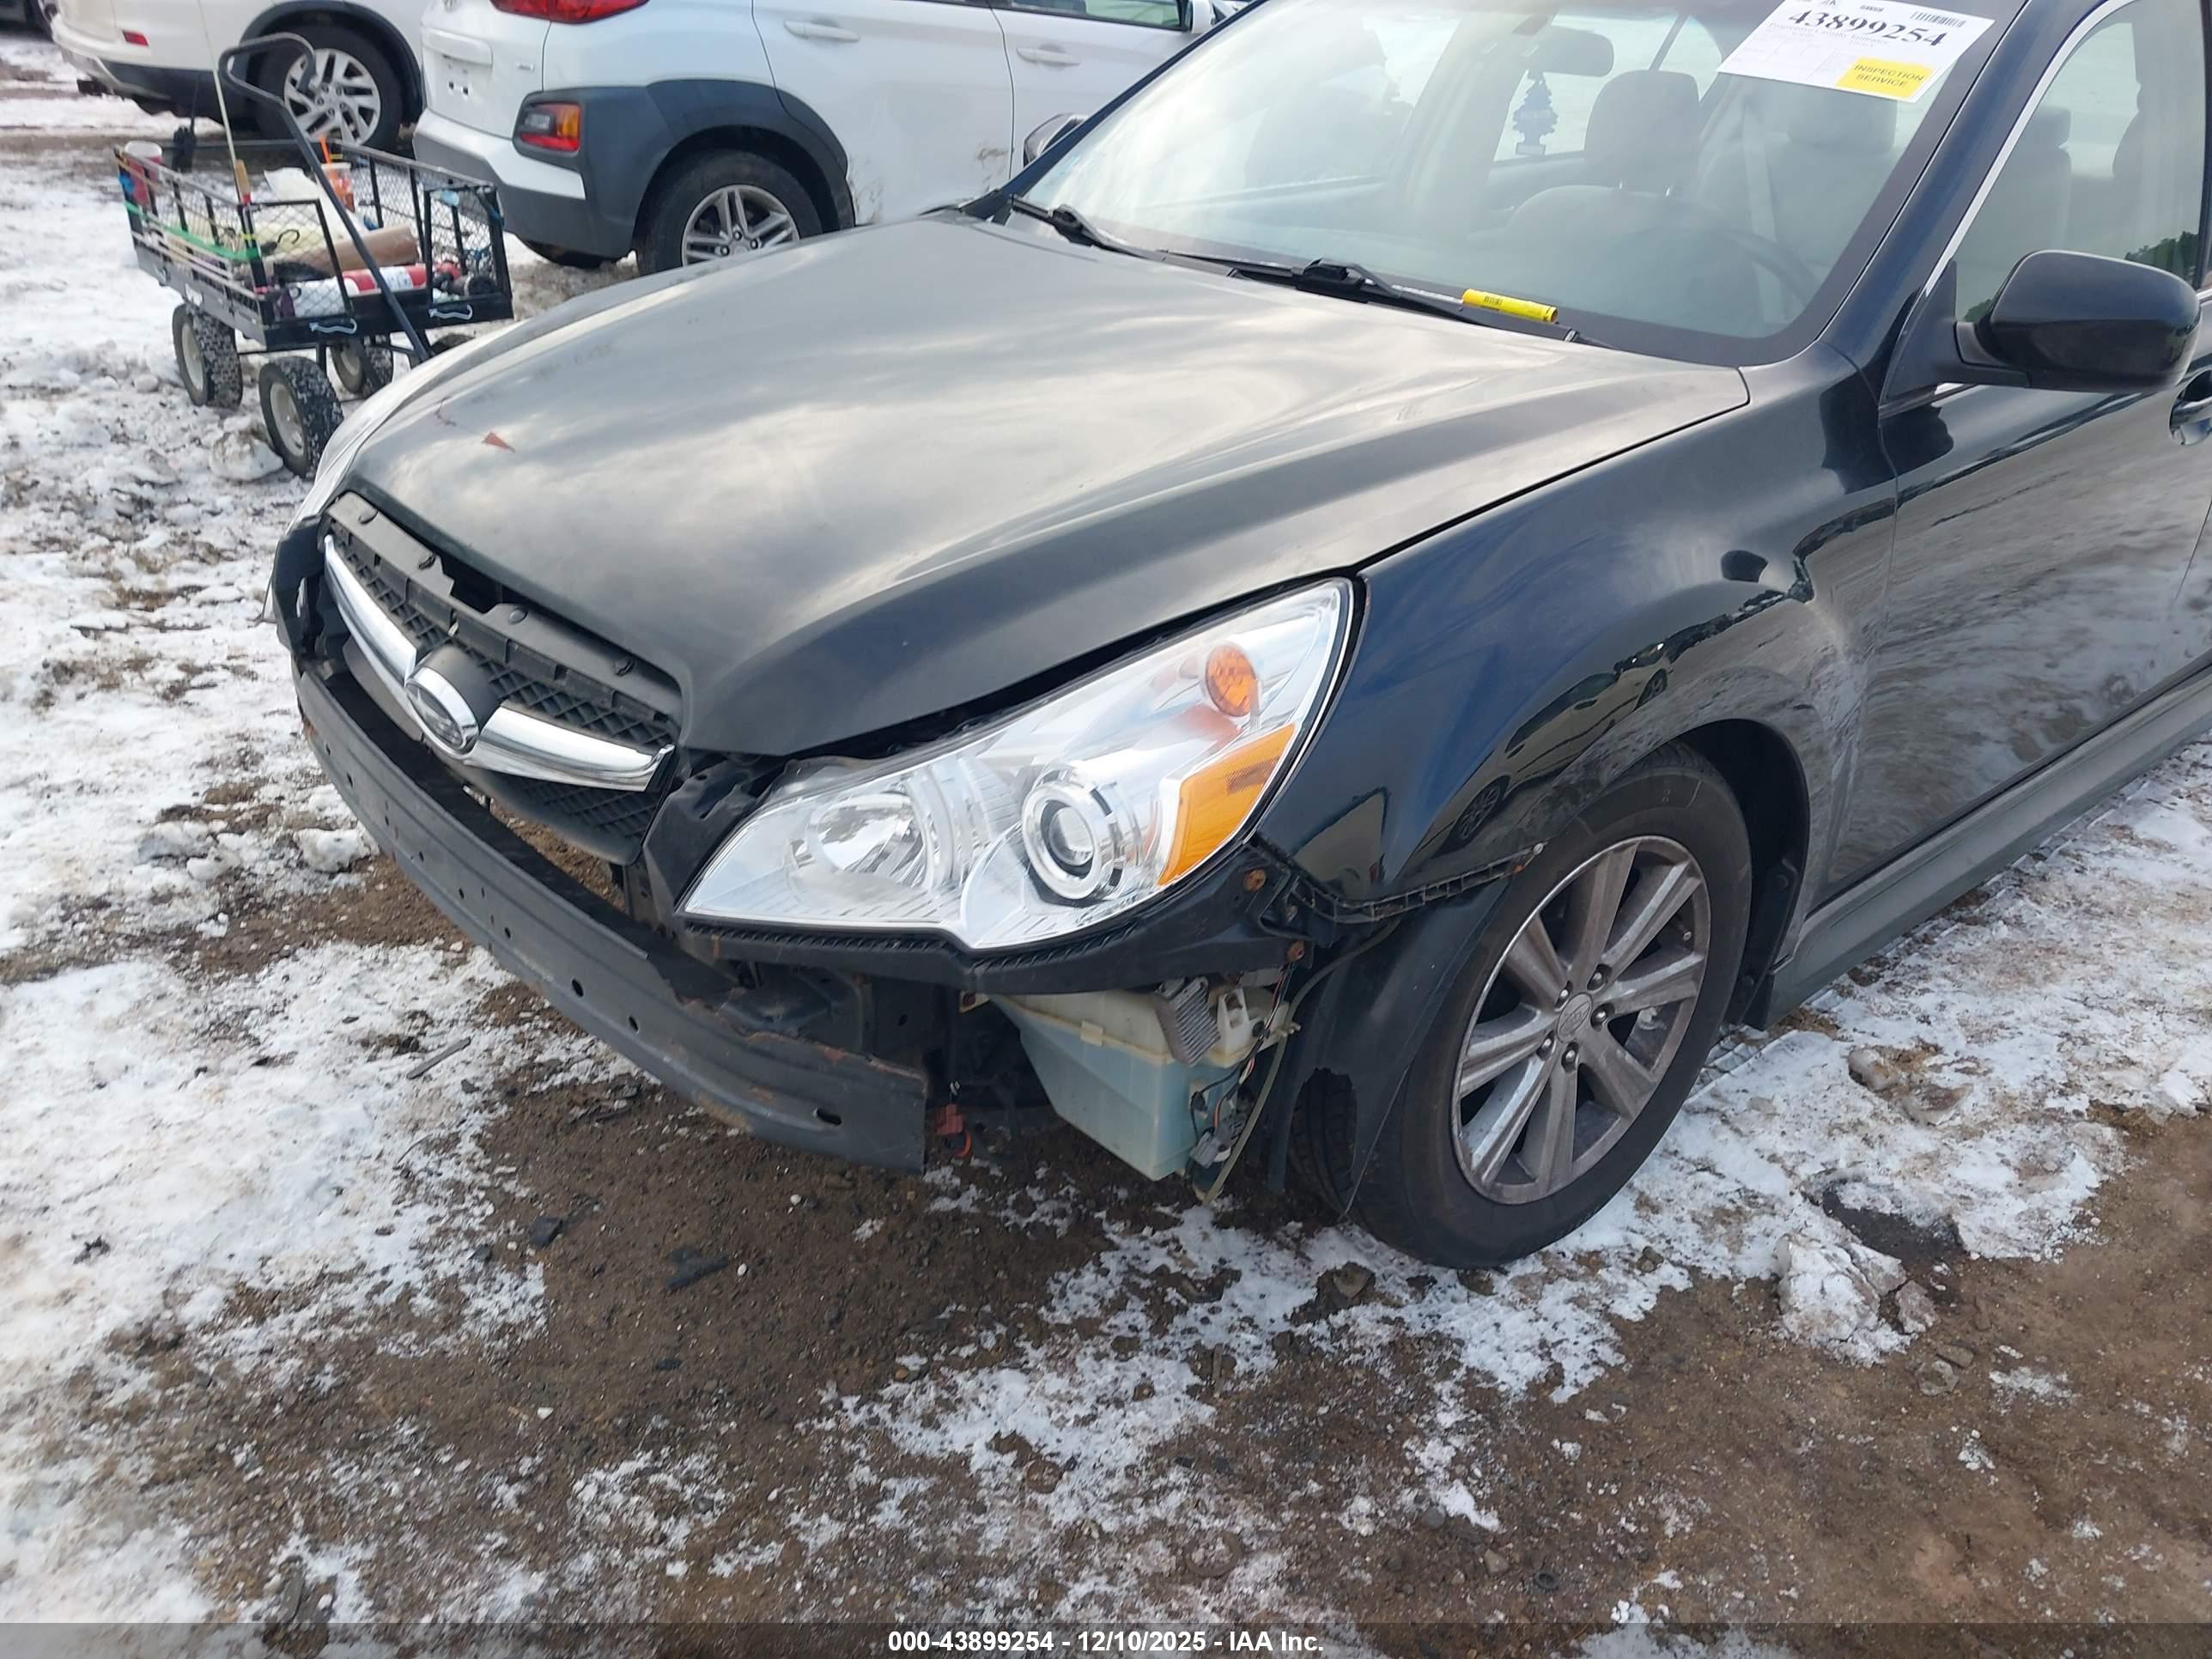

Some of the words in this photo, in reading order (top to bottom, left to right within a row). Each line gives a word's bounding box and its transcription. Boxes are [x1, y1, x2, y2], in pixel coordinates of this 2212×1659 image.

[1788, 9, 1948, 46] 43899254
[1854, 64, 1924, 82] INSPECTION
[1856, 74, 1908, 88] SERVICE
